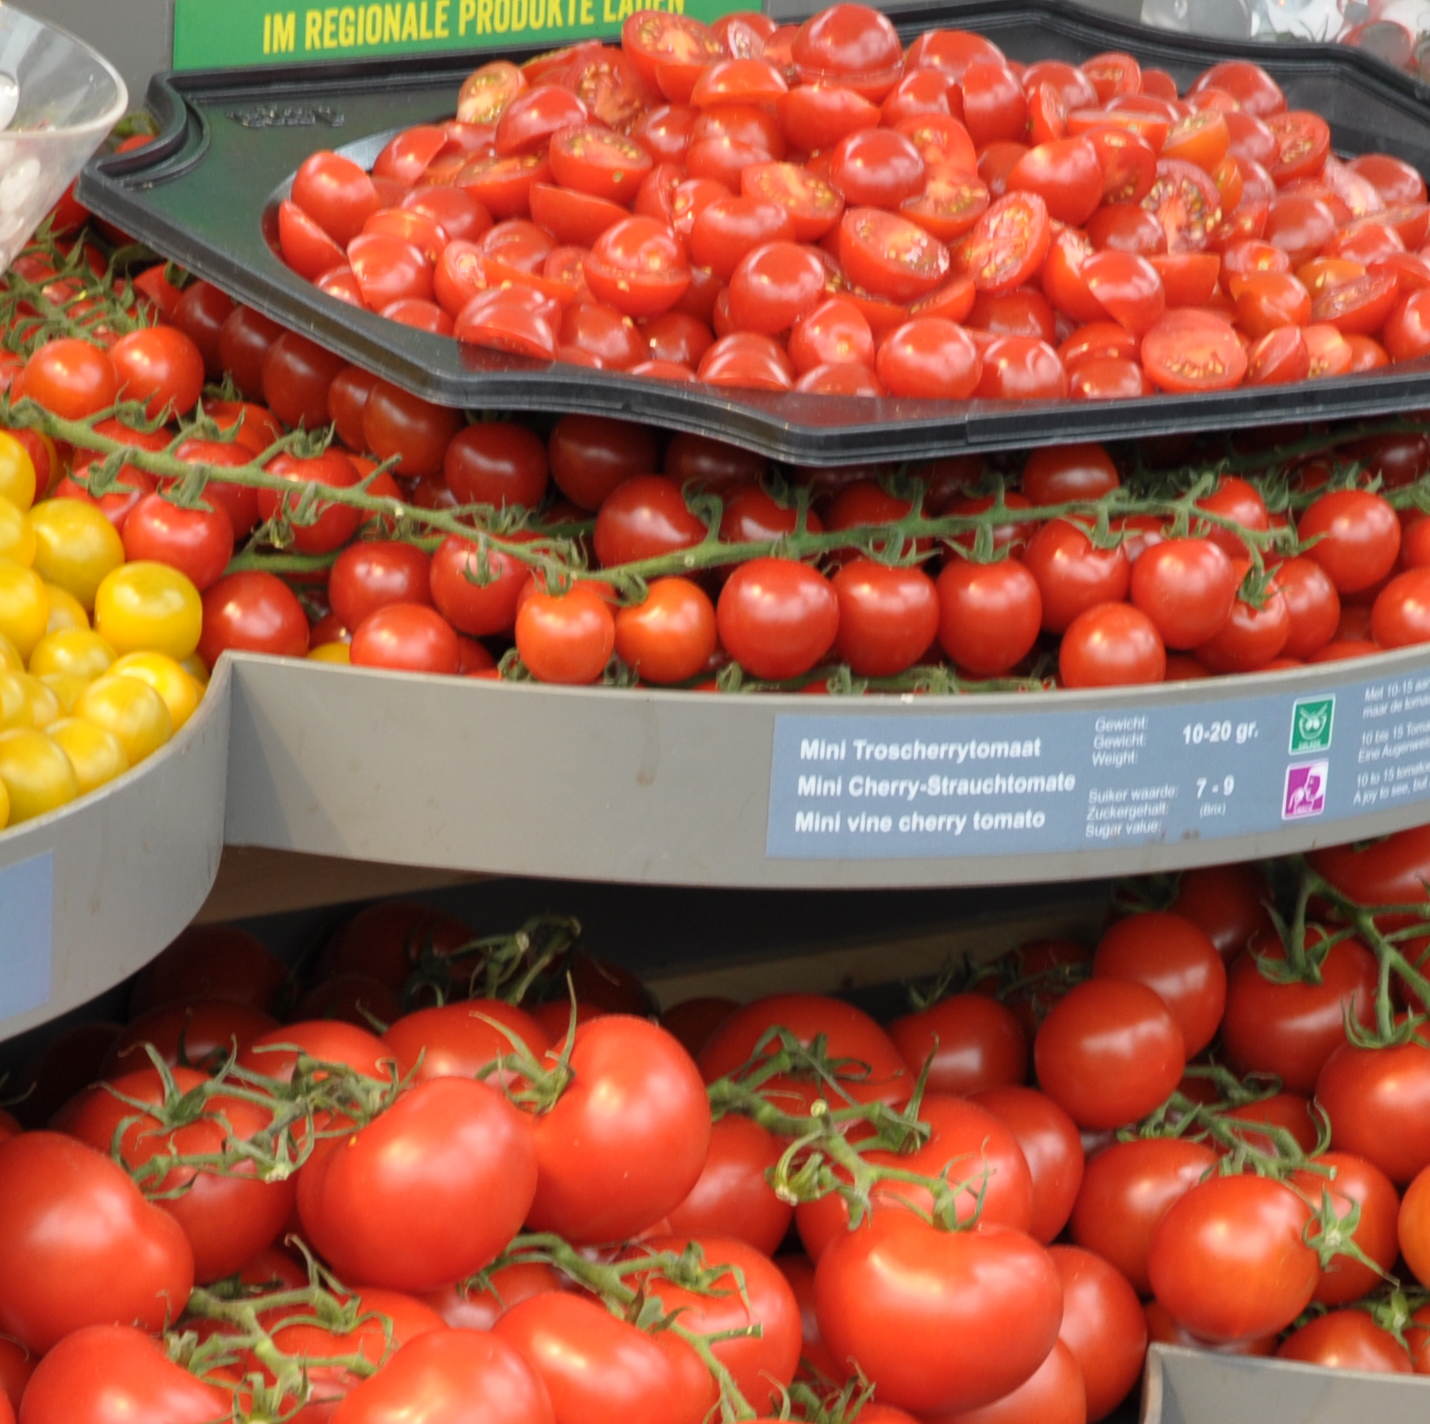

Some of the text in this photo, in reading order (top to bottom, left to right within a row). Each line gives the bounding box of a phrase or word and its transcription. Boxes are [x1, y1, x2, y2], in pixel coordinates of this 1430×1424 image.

[262, 15, 297, 54] IM
[304, 0, 450, 49] REGIONALE
[457, 0, 595, 37] PRODUKTE
[1182, 720, 1259, 745] 10-20 gr.
[799, 738, 1042, 762] Mini Troscherrytomaat
[797, 774, 1077, 799] Mini Cherry-Strauchtomate
[1196, 777, 1208, 799] 7
[1222, 774, 1235, 797] 9
[794, 810, 1047, 836] Mini vine cherry tomato
